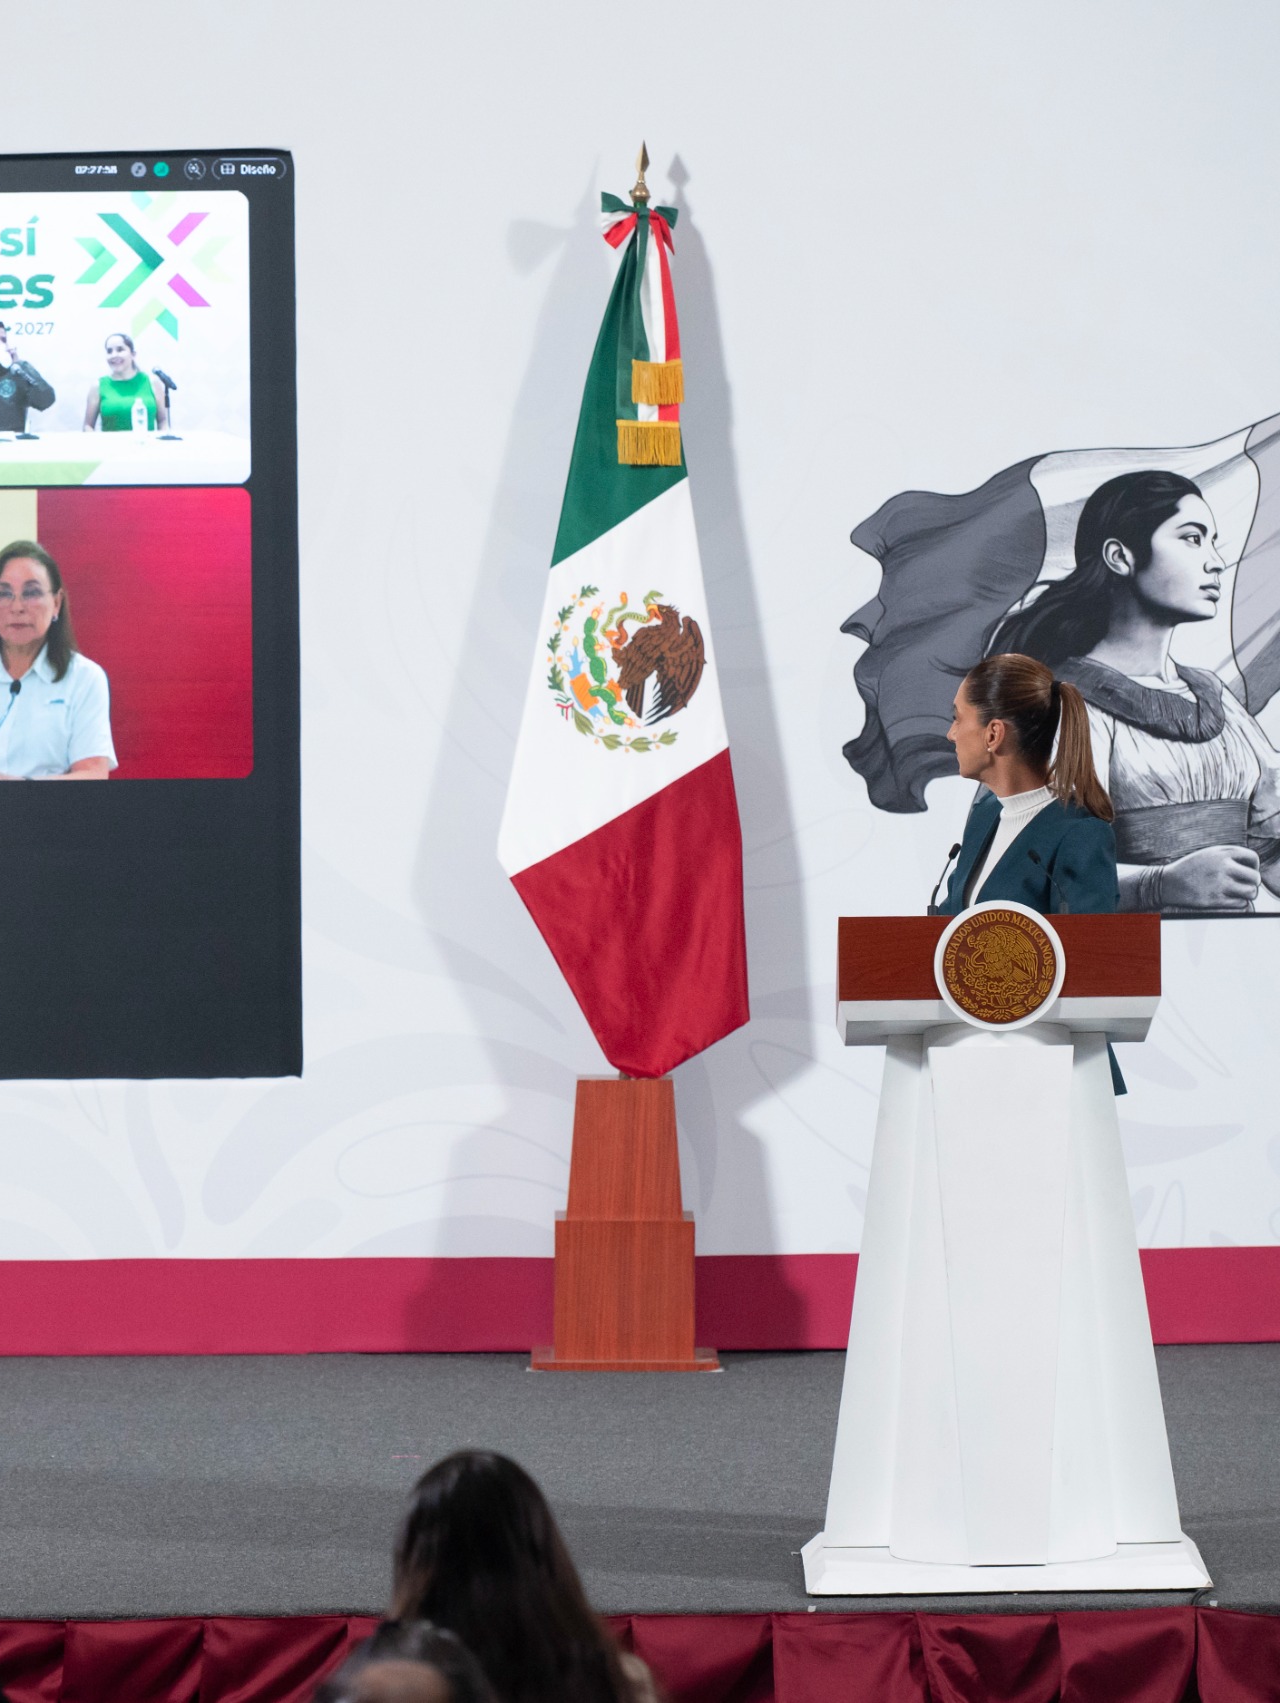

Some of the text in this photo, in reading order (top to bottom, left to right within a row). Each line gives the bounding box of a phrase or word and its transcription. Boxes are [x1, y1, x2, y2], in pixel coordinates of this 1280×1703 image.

[240, 163, 277, 175] Diseño
[15, 322, 55, 335] 2027
[945, 911, 1054, 967] ESTADOS UNIDOS MEXICANOS
